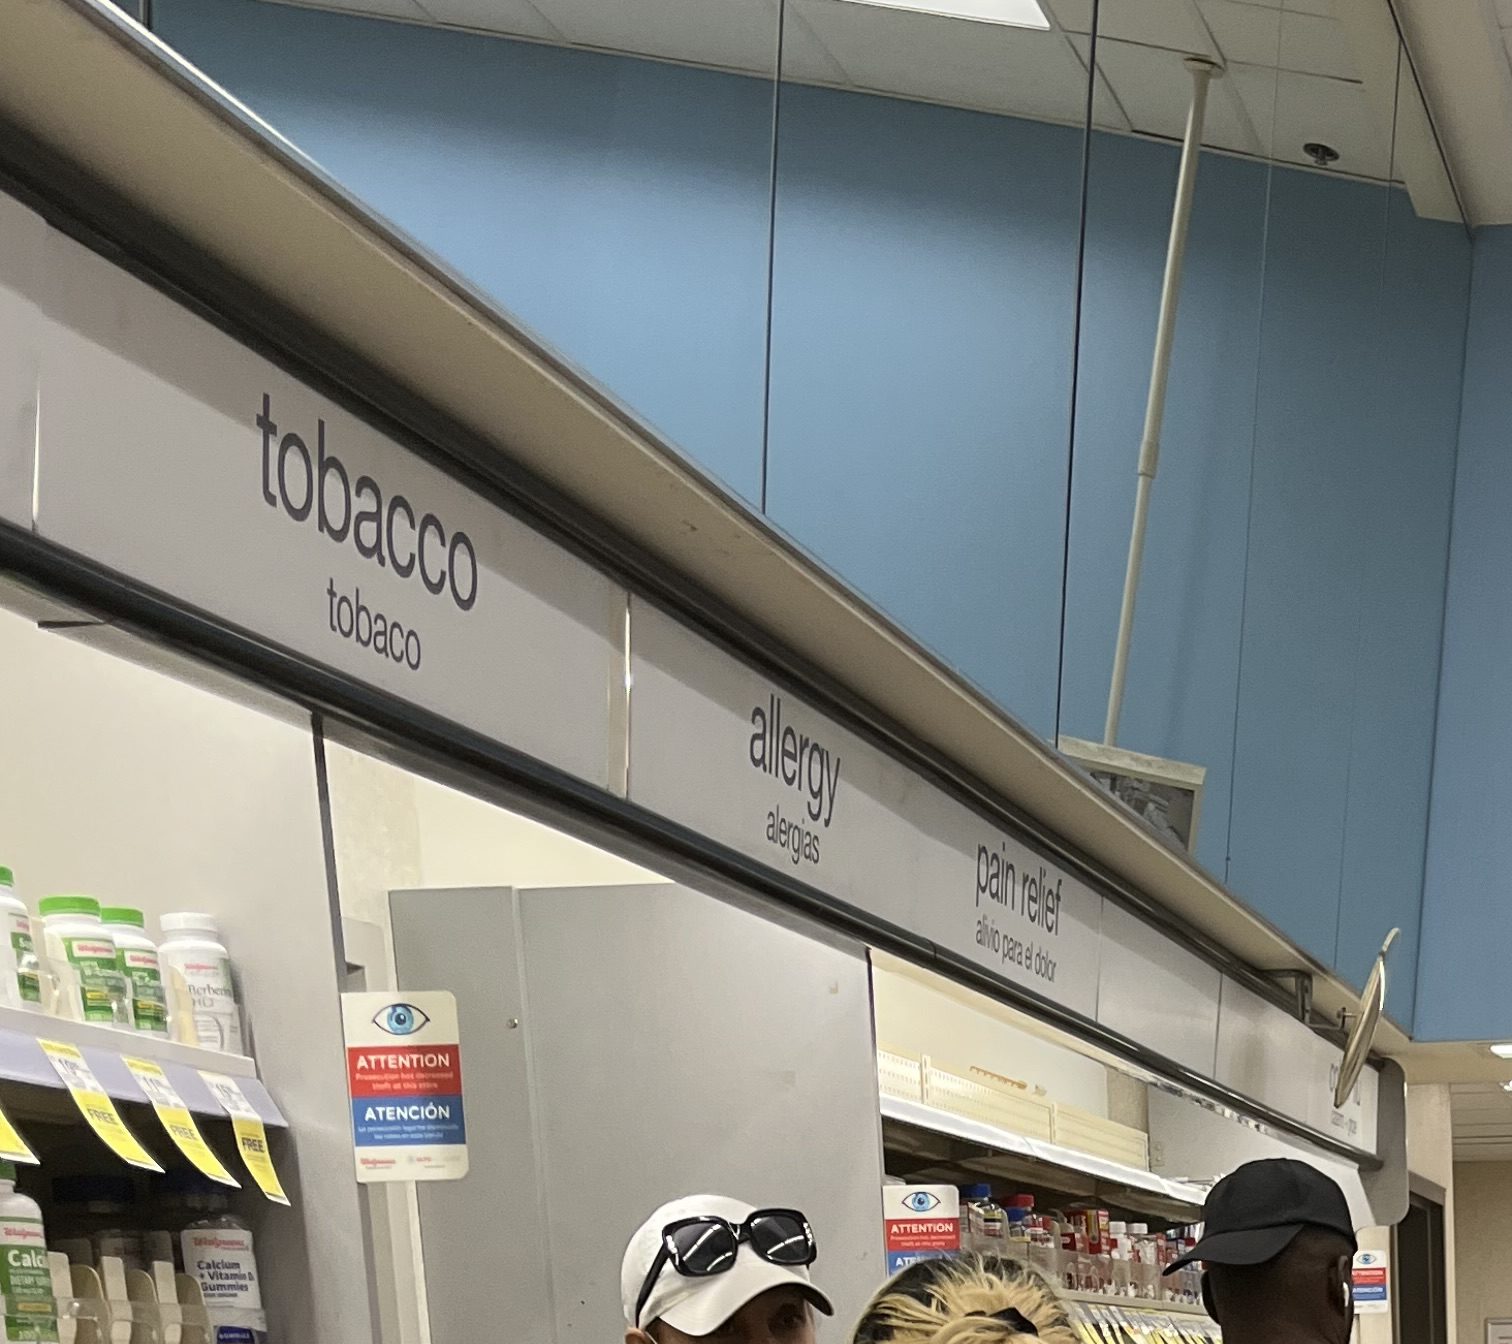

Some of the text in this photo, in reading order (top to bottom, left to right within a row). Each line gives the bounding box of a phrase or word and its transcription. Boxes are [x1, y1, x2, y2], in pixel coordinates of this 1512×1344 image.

[256, 392, 478, 611] tobacco
[326, 577, 422, 671] tobaco
[749, 693, 841, 827] allergy
[766, 804, 820, 865] alergias
[975, 842, 1062, 936] pain relief
[976, 917, 1057, 983] alivio para el dolor
[356, 1053, 450, 1070] ATTENTION
[364, 1102, 450, 1121] ATENCIÓN
[890, 1223, 954, 1234] ATTENTION
[197, 1260, 241, 1270] Calcium
[201, 1281, 250, 1293] Gummies
